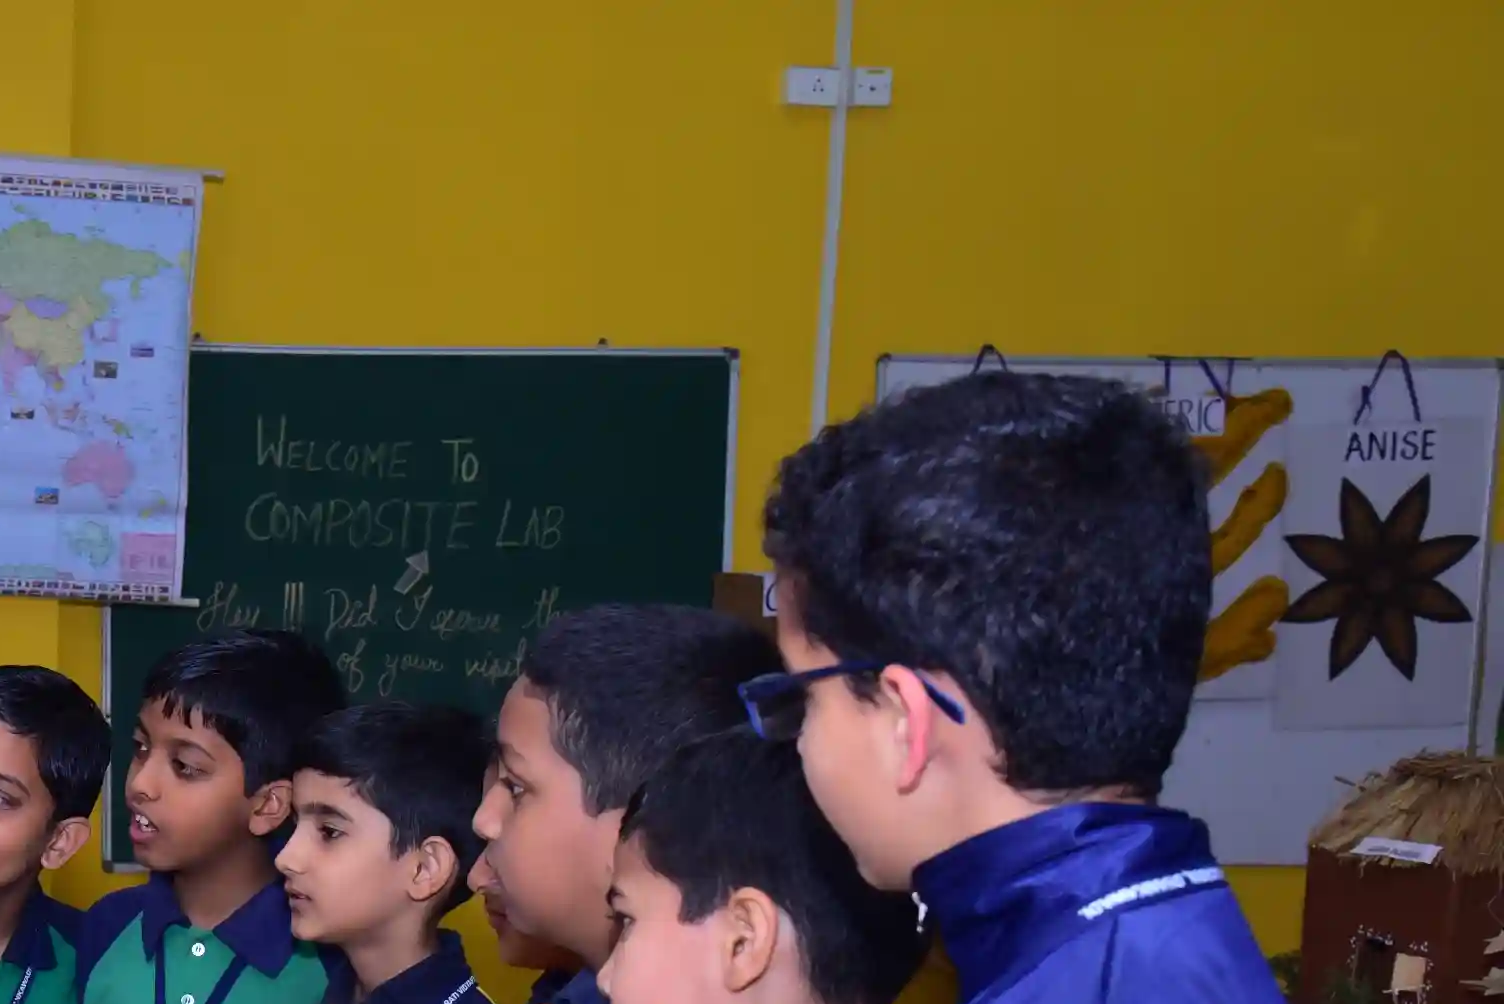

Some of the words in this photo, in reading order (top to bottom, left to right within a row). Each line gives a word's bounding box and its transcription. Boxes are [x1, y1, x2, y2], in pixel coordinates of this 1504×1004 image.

[257, 414, 412, 478] WELCOME
[1345, 430, 1436, 462] ANISE
[246, 492, 478, 549] COMPOSITE
[496, 498, 564, 549] LAB
[324, 584, 377, 641] Did
[337, 639, 367, 693] of
[378, 654, 444, 697] your
